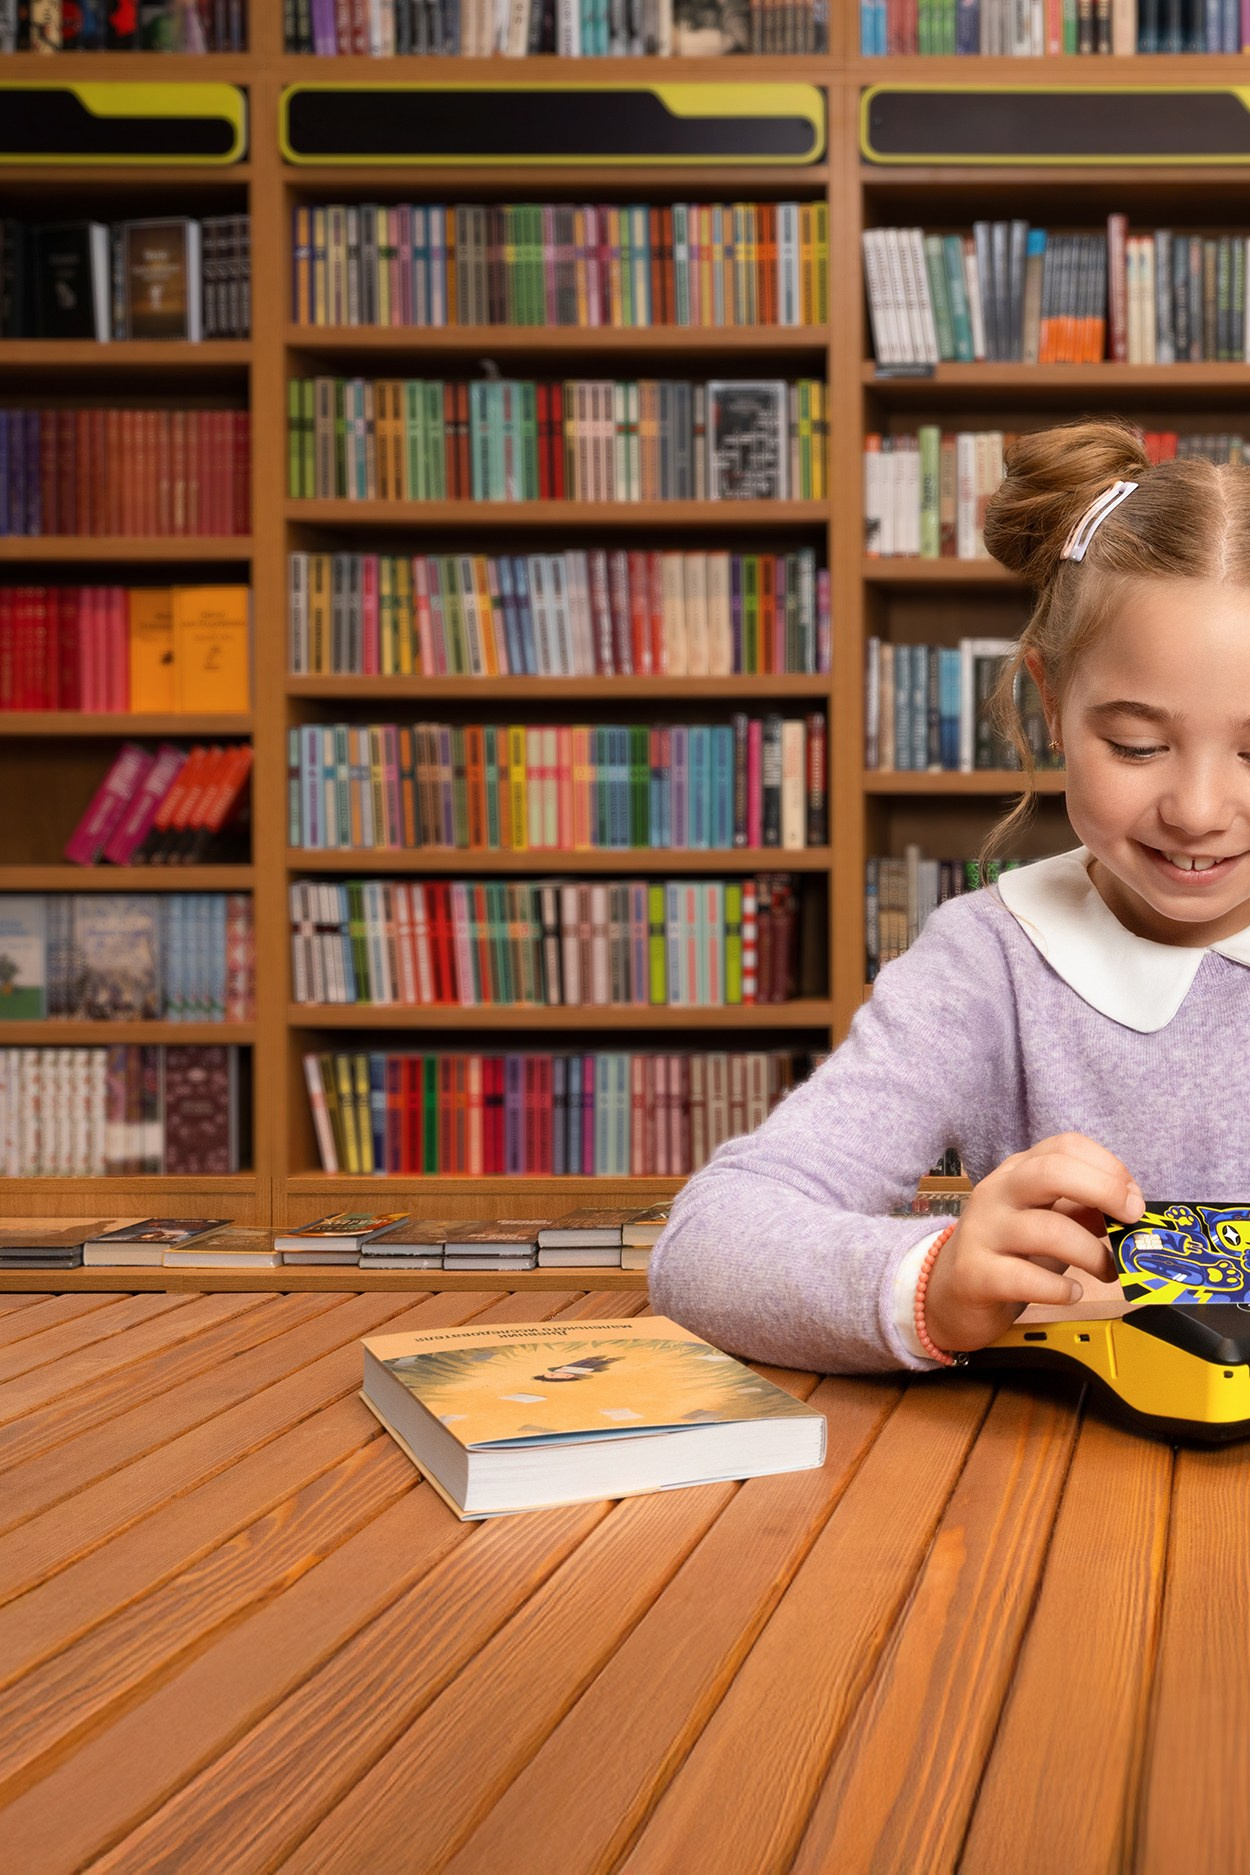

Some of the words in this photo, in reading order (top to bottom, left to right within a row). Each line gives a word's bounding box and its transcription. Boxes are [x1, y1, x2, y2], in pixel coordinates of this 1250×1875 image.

[542, 1324, 633, 1332] маленького
[415, 1328, 539, 1342] исследователя
[499, 1330, 568, 1339] Дневник
